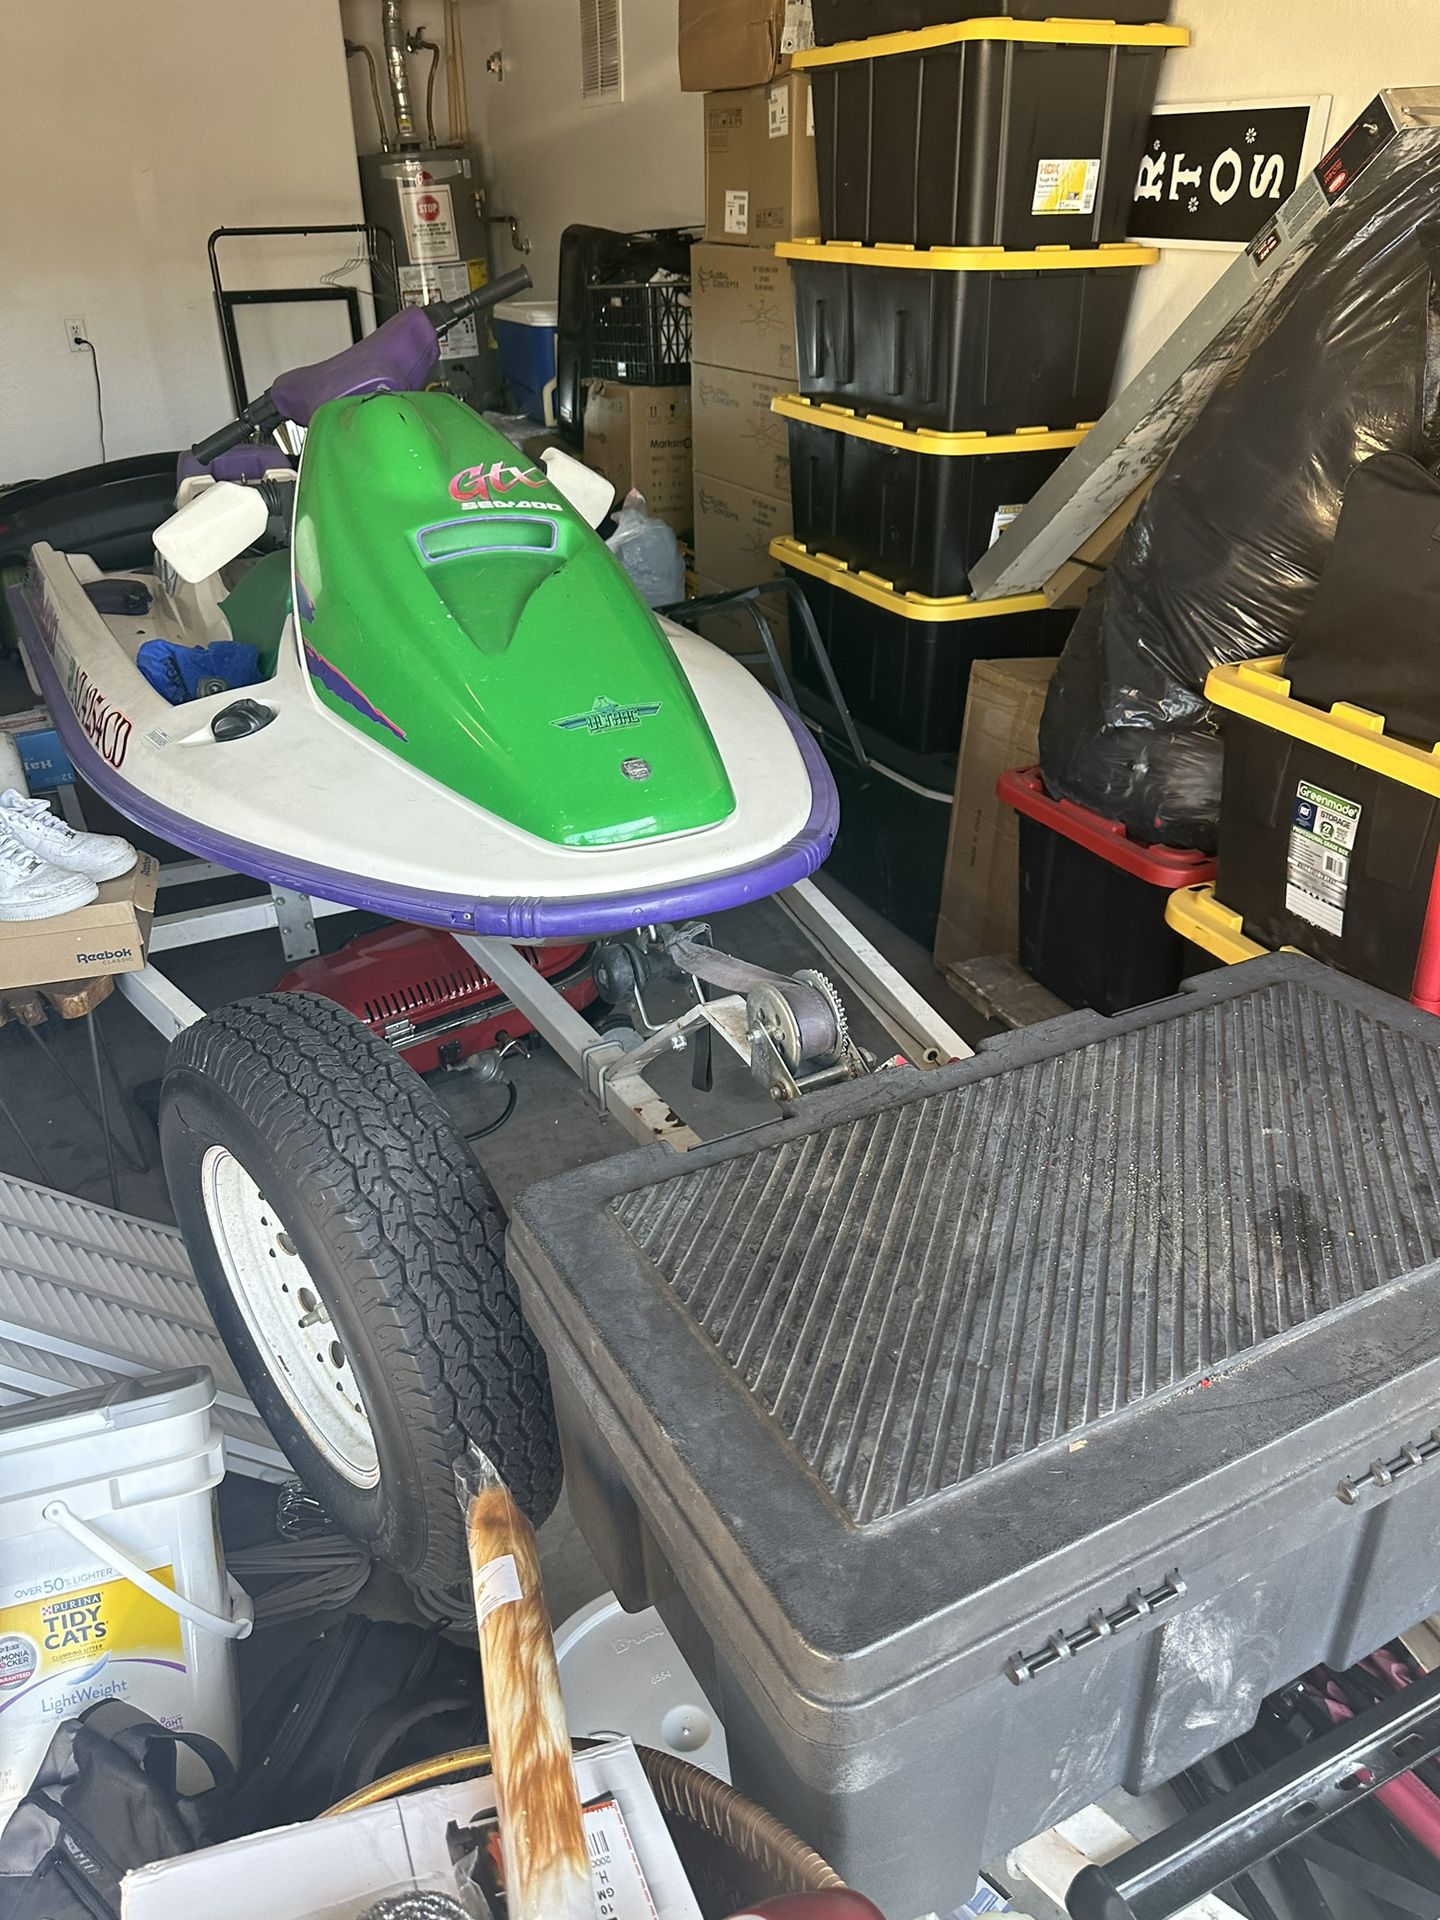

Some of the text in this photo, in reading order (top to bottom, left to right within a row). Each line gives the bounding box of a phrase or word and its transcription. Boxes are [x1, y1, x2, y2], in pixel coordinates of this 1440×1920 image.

[418, 203, 438, 214] STOP
[1299, 785, 1357, 818] Greenmade
[1320, 810, 1352, 830] STORAGE
[1321, 822, 1332, 834] 27
[1338, 847, 1349, 857] BOX
[76, 948, 133, 964] Reebok
[102, 956, 134, 966] CLASSIC
[14, 1586, 42, 1599] OVER
[72, 1567, 114, 1586] LIGHTER
[52, 1592, 101, 1614] PURINA
[43, 1604, 102, 1633] TIDY
[44, 1621, 108, 1650] CATS
[52, 1648, 82, 1662] CLUMPING
[83, 1643, 103, 1655] LITTER
[41, 1679, 128, 1714] LightWeight
[597, 1887, 615, 1900] GM
[600, 1904, 614, 1916] 10
